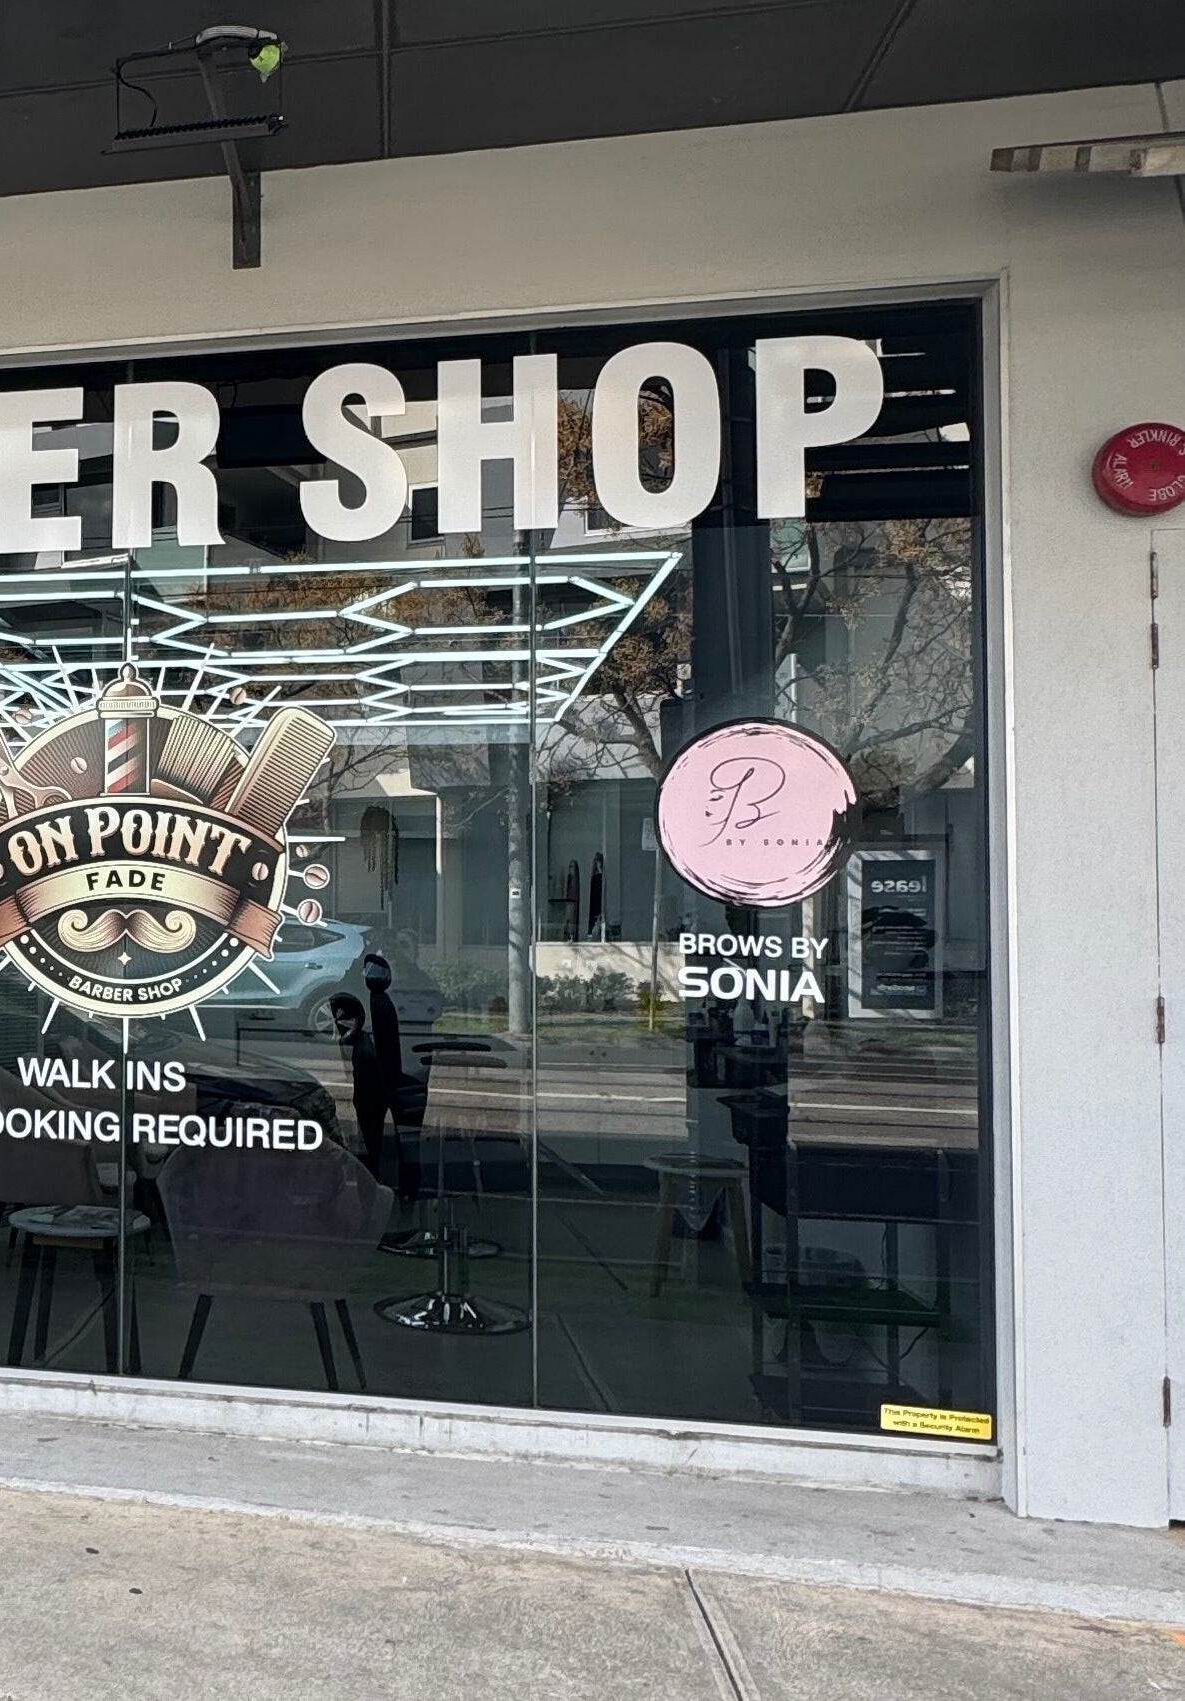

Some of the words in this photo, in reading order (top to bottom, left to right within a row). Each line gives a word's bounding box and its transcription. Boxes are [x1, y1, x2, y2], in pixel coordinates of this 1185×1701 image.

[300, 335, 884, 542] SHOP
[8, 815, 79, 876] ON
[84, 806, 252, 876] POINT
[726, 838, 746, 847] BY
[763, 838, 824, 847] SONIA
[86, 870, 166, 891] FADE
[679, 933, 782, 958] BROWS
[792, 937, 829, 959] BY
[68, 976, 133, 1002] BARBER
[138, 978, 183, 1001] SHOP
[678, 966, 825, 1003] SONIA
[17, 1057, 115, 1089] WALK
[126, 1060, 186, 1093] INS
[133, 1113, 323, 1151] REQUIRED
[903, 1410, 937, 1420] Property
[949, 1414, 989, 1424] Protected
[920, 1421, 953, 1431] Security
